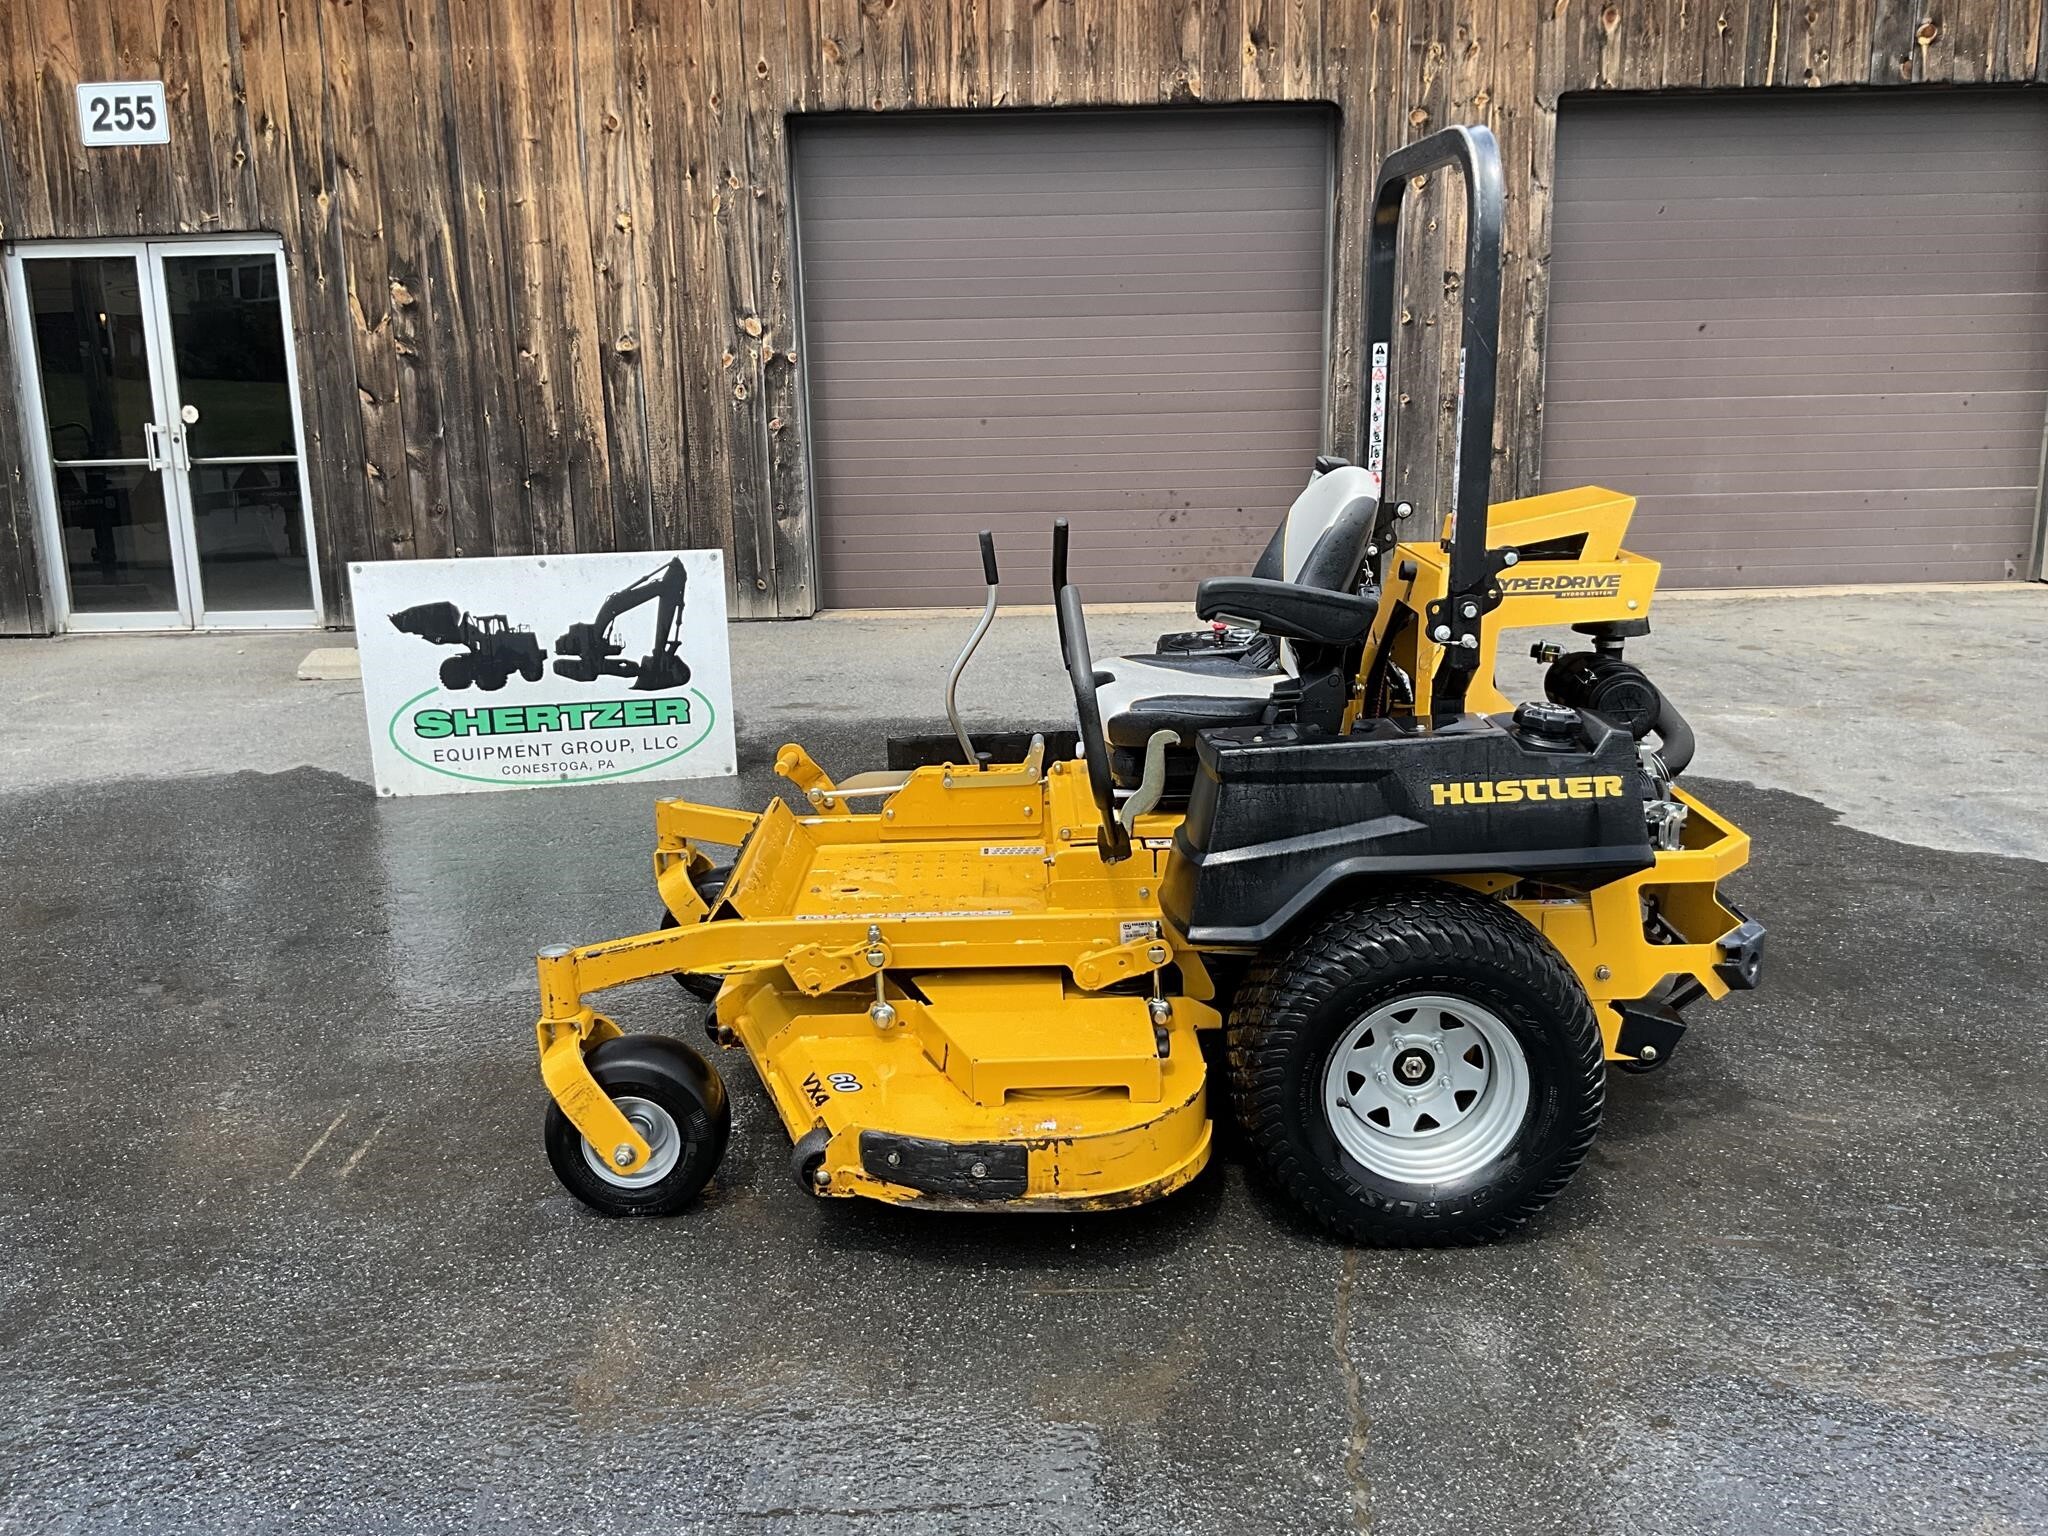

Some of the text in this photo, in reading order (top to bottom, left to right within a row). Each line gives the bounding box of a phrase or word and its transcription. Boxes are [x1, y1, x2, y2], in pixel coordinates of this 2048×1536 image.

[90, 95, 157, 132] 255
[413, 696, 691, 739] SHERTZER
[433, 735, 679, 763] EQUIPMENT GROUP, LLC
[501, 759, 615, 775] CONESTOGA, PA
[1430, 775, 1624, 806] HUSTLER
[802, 1071, 831, 1108] VX4
[827, 1072, 863, 1093] 60
